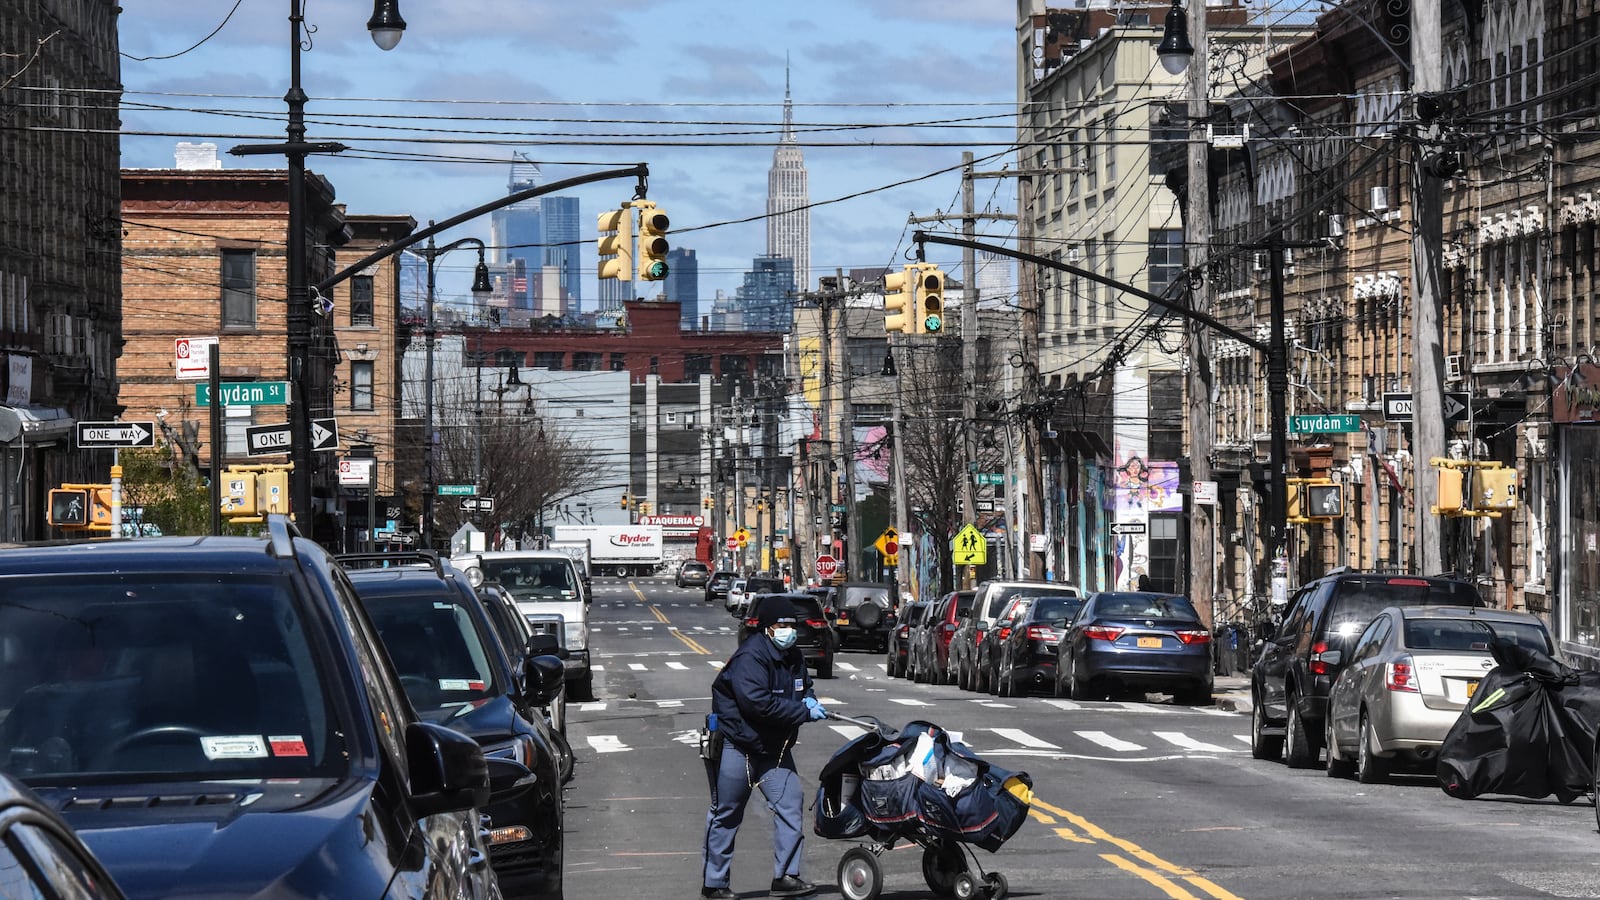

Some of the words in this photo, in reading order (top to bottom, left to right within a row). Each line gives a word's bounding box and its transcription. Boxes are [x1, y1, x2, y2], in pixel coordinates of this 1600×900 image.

[205, 385, 264, 406] Sydam
[270, 385, 279, 396] St
[1395, 402, 1413, 413] ON
[1443, 402, 1456, 413] AY
[1295, 416, 1341, 433] Suydam
[1345, 418, 1353, 426] St
[89, 430, 110, 439] ONE
[120, 430, 142, 439] WAY
[260, 433, 286, 446] ONE
[442, 486, 471, 494] Willoughby
[651, 517, 693, 525] TAQUERIA
[620, 534, 651, 544] Ryder
[817, 561, 835, 571] STOP
